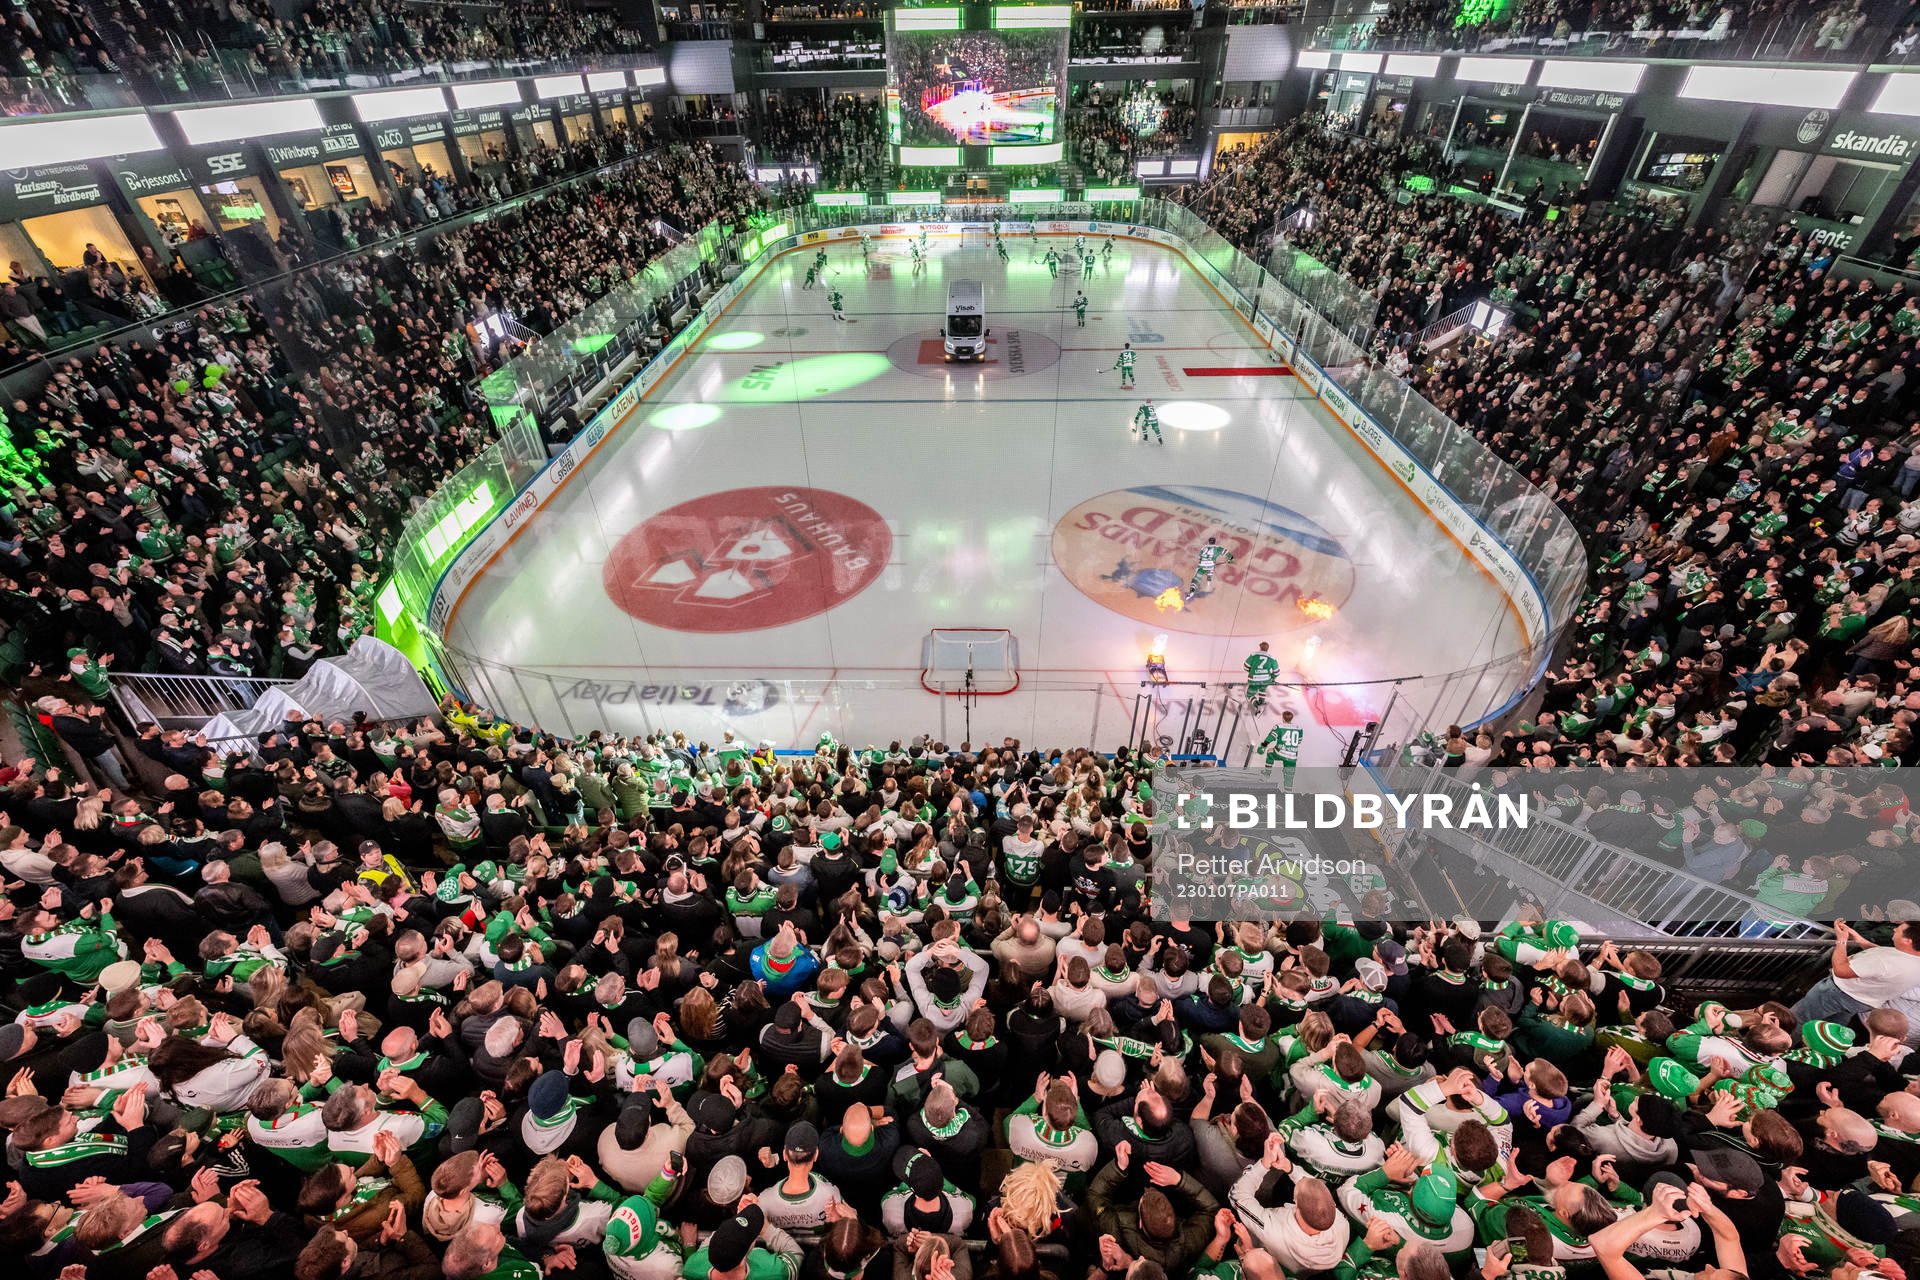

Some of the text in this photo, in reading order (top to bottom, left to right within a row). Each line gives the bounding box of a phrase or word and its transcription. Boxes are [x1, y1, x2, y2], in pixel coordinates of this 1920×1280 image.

[377, 132, 403, 148] DACO
[1831, 130, 1909, 156] skandia
[278, 145, 320, 161] Wihlborgs
[206, 152, 247, 175] SSE
[14, 180, 57, 194] Karlsson
[1808, 227, 1854, 250] renta
[611, 390, 637, 420] CATENA
[557, 449, 572, 466] INTER
[556, 459, 575, 481] SYSTEM
[774, 492, 872, 571] BAUHAUS
[1258, 656, 1268, 670] 7
[560, 678, 714, 706] Telia Play
[1281, 730, 1300, 747] 40
[1349, 875, 1374, 891] 65
